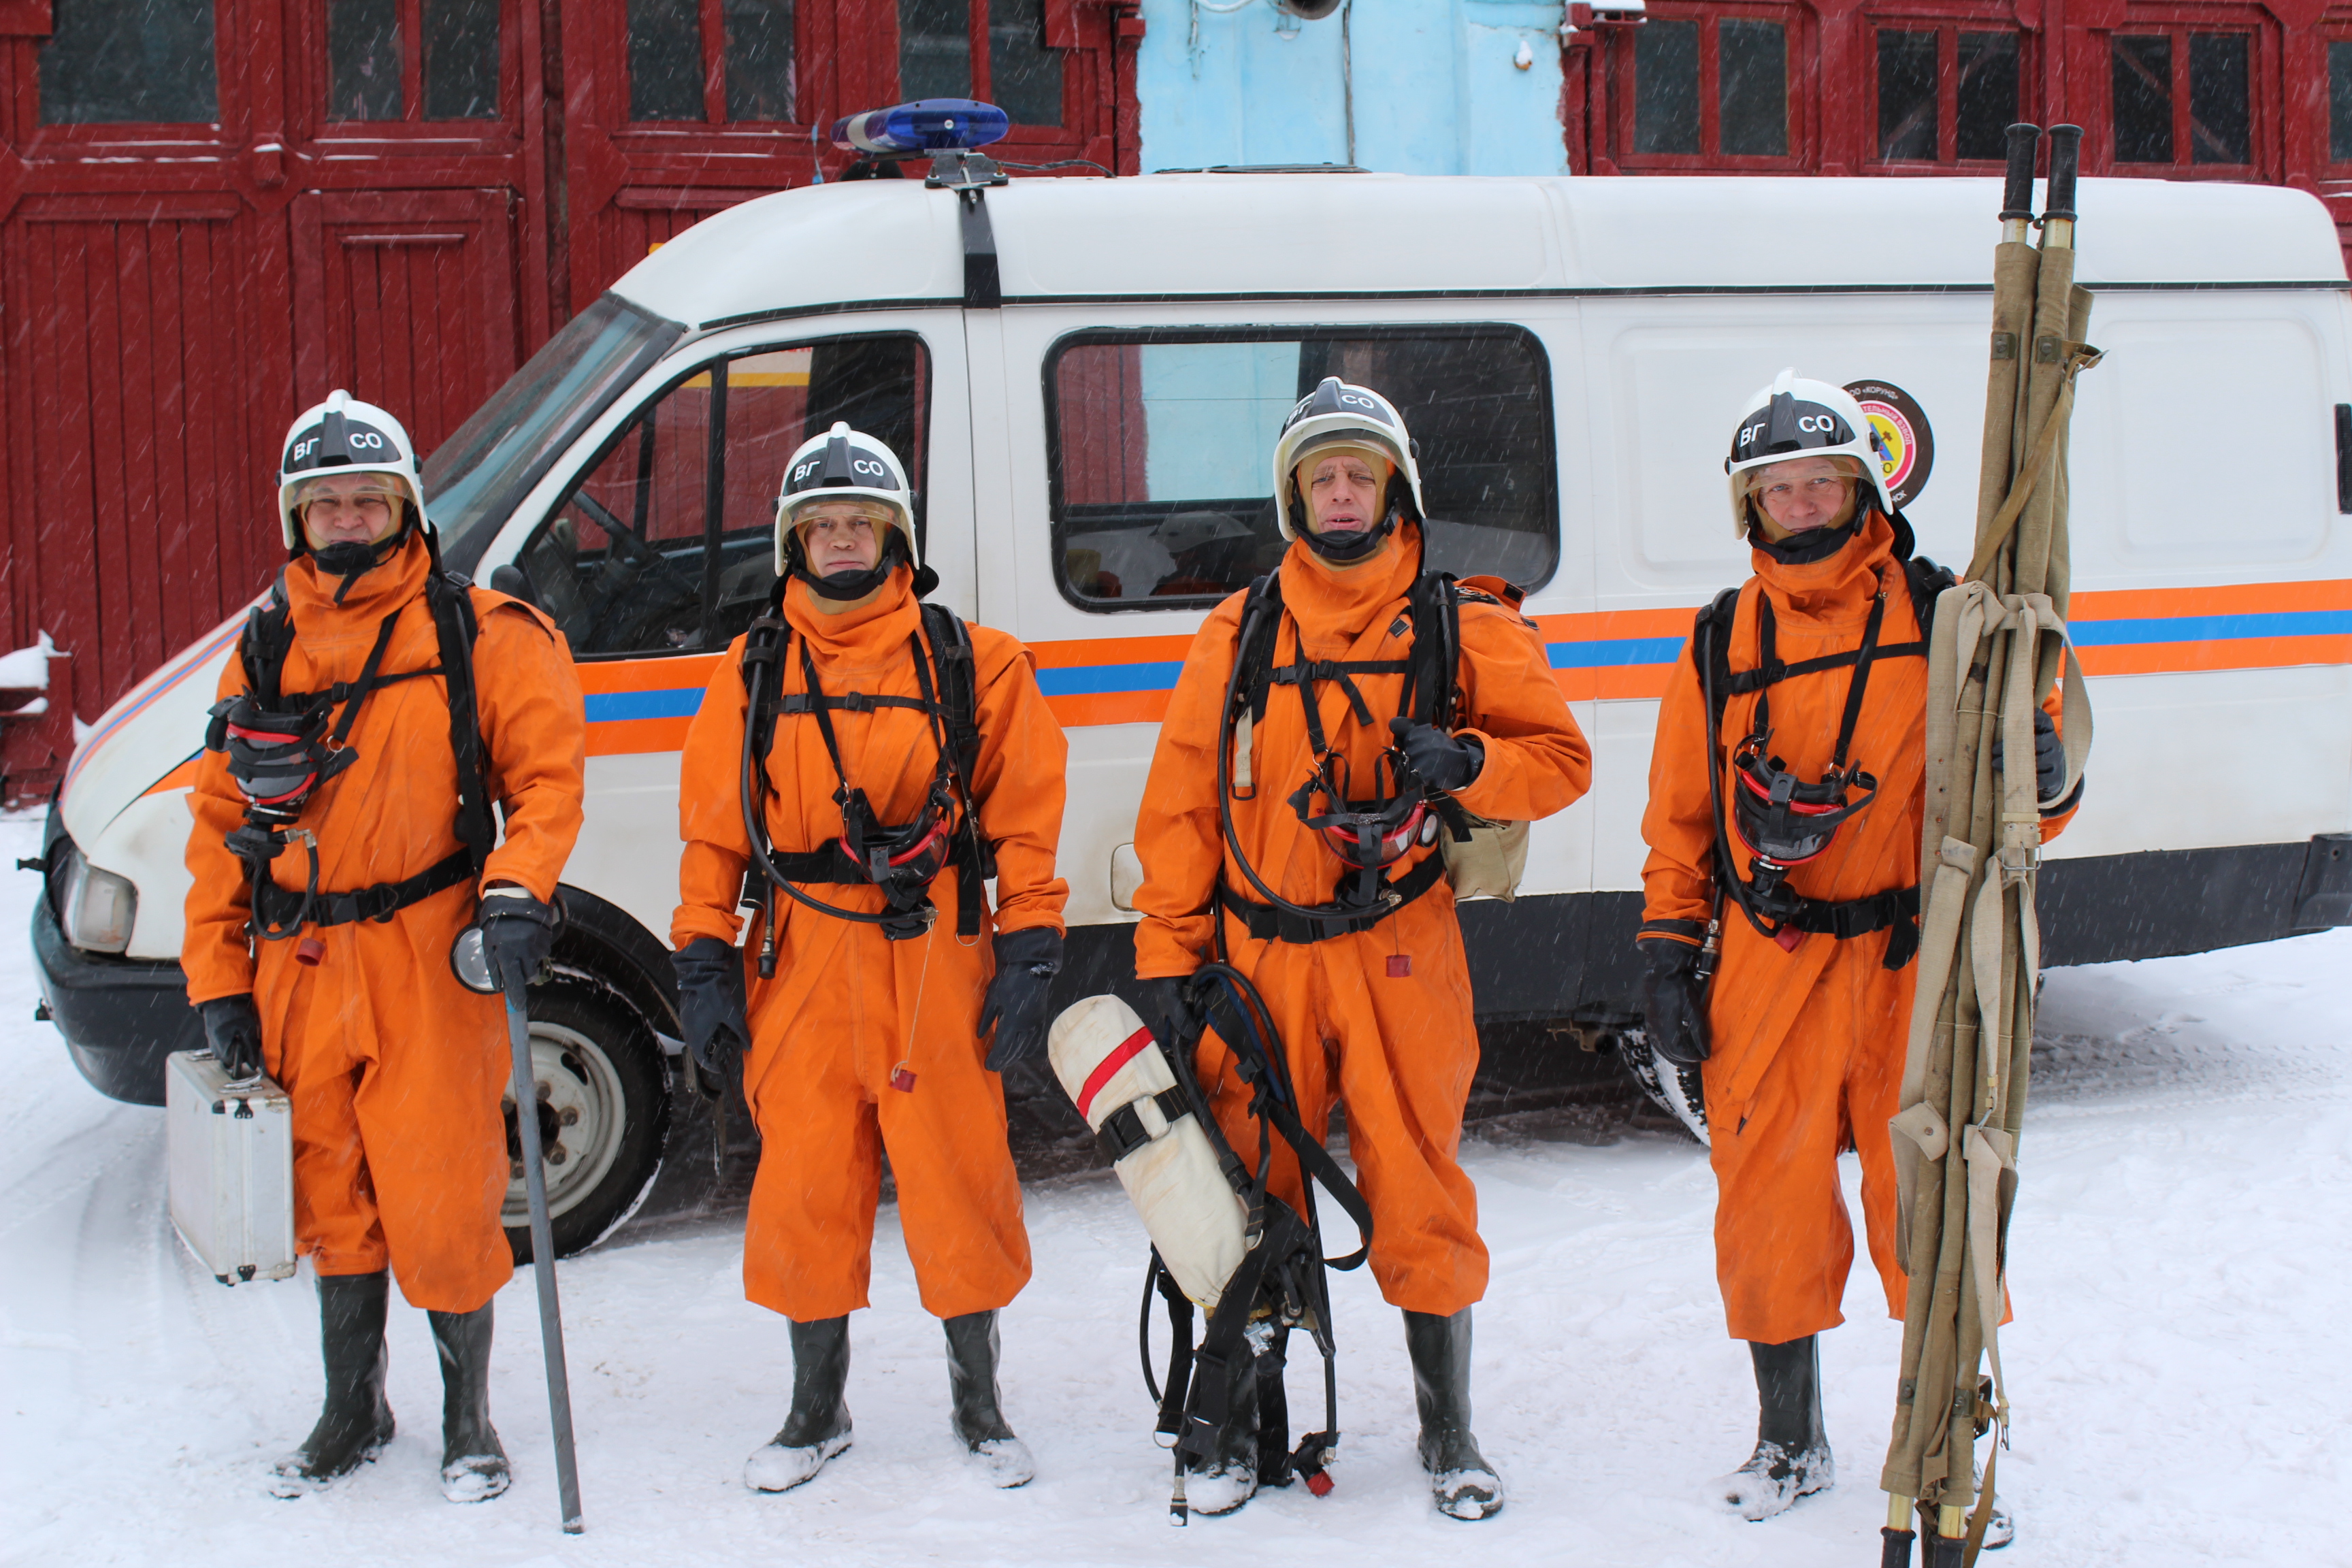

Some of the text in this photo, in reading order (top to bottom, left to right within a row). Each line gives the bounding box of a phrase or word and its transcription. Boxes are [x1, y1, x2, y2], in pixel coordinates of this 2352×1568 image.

[1288, 395, 1374, 425] ВГ СО
[1740, 414, 1834, 448] ВГ СО
[293, 432, 383, 461] ВГ СО
[794, 459, 884, 482] ВГ СО
